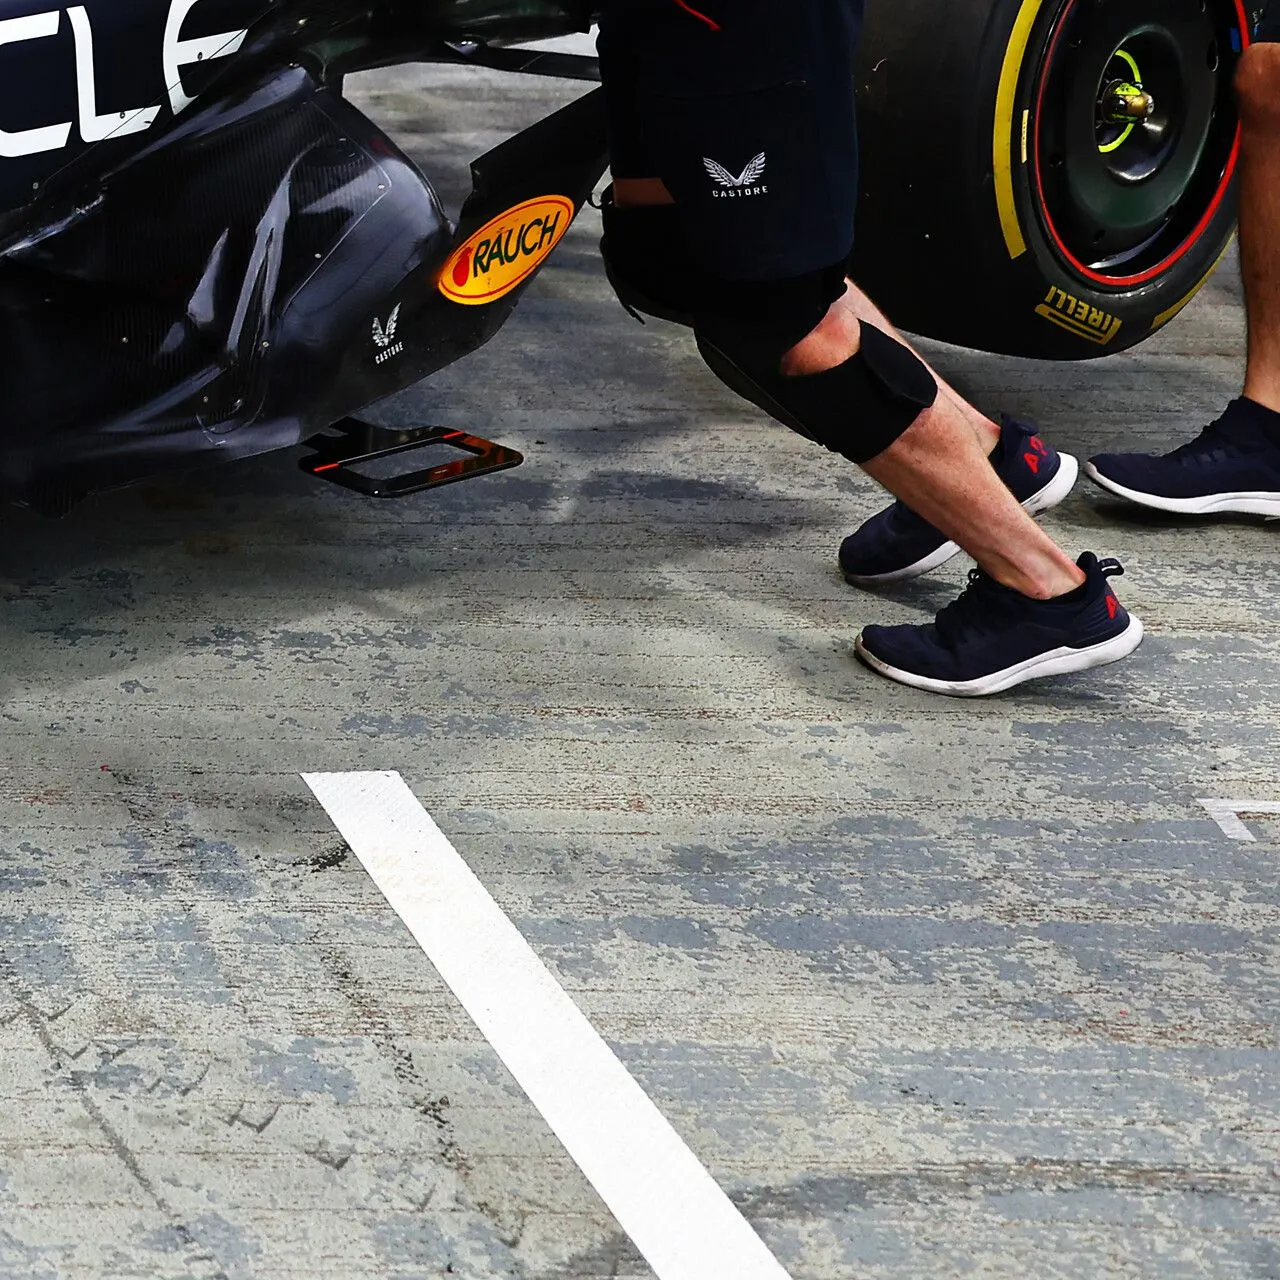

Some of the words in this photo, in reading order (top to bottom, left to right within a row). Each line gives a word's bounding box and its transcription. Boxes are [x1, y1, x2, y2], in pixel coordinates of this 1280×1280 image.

[712, 184, 769, 199] CASTORE
[472, 210, 561, 279] RAUCH
[1034, 284, 1123, 346] PIRELLI
[375, 340, 405, 366] CASTORE
